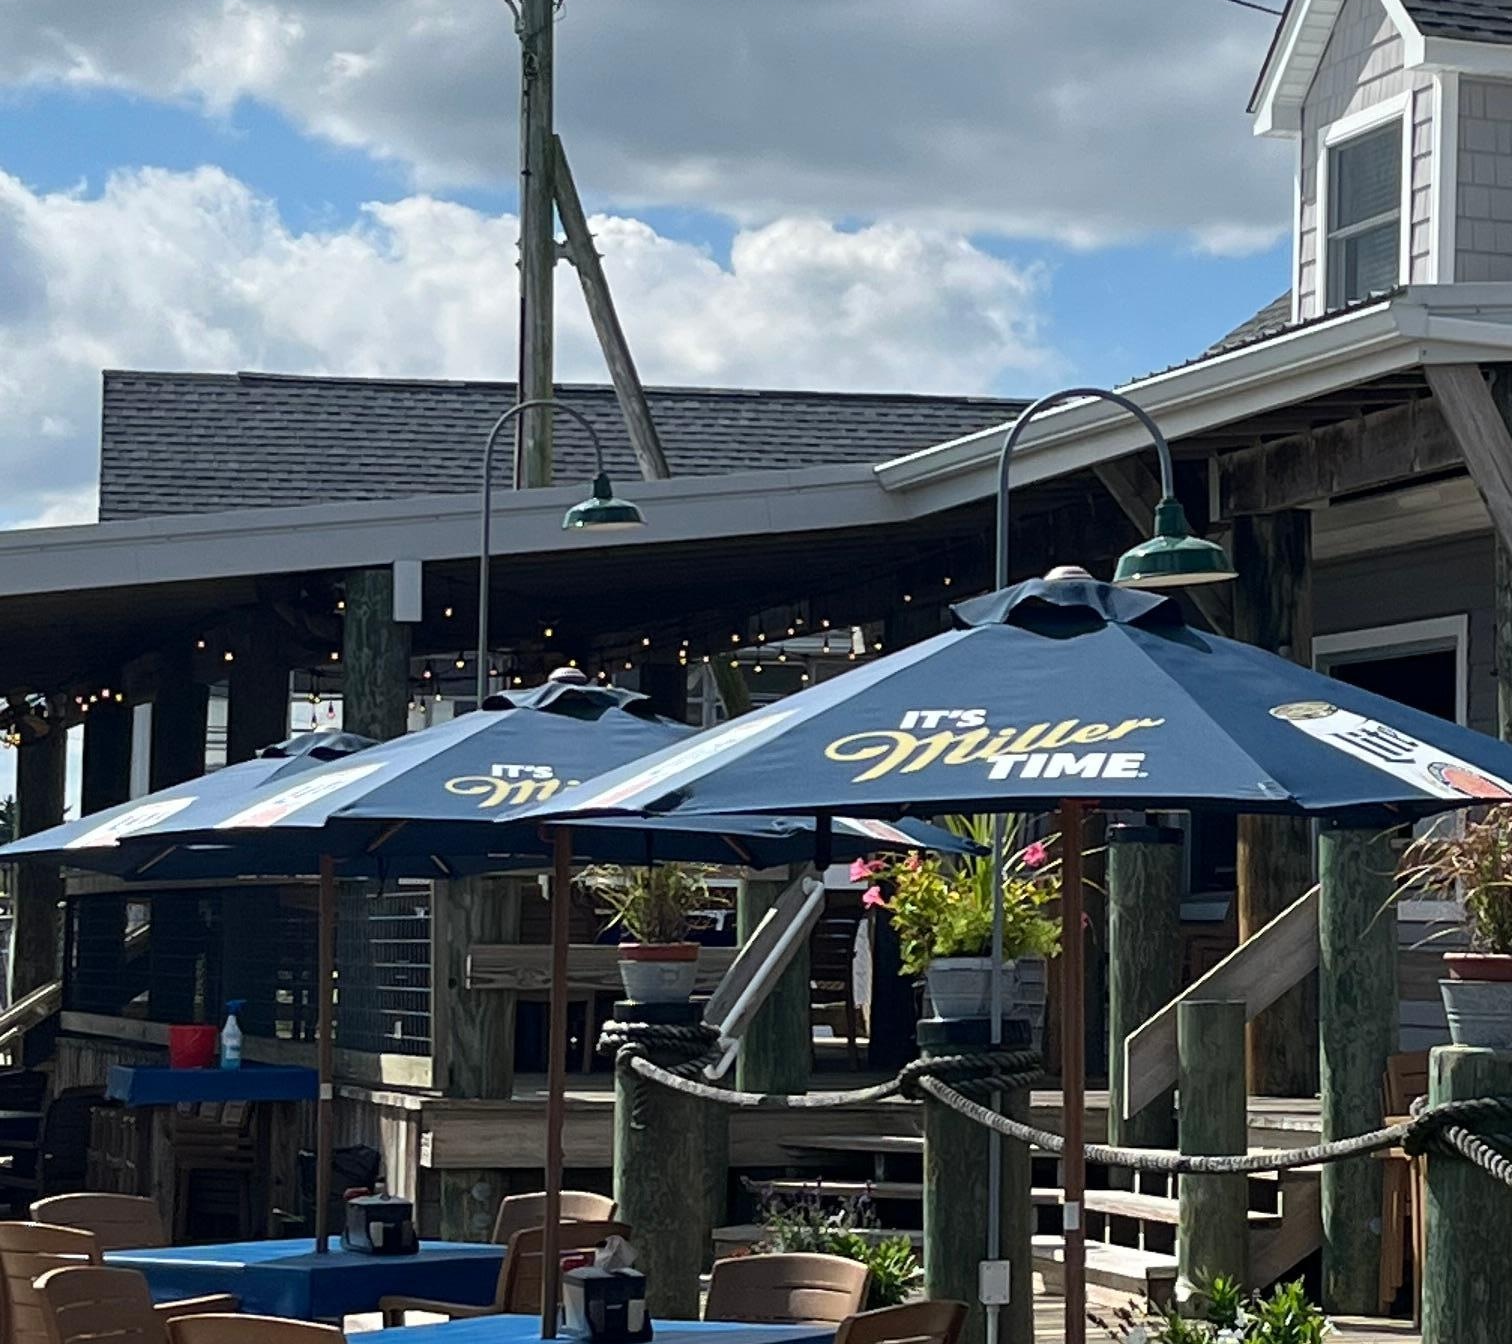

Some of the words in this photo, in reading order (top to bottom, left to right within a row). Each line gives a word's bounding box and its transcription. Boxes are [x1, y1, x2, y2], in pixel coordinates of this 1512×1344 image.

[899, 708, 987, 730] IT'S
[823, 718, 1166, 784] Miller
[491, 763, 554, 779] IT'S
